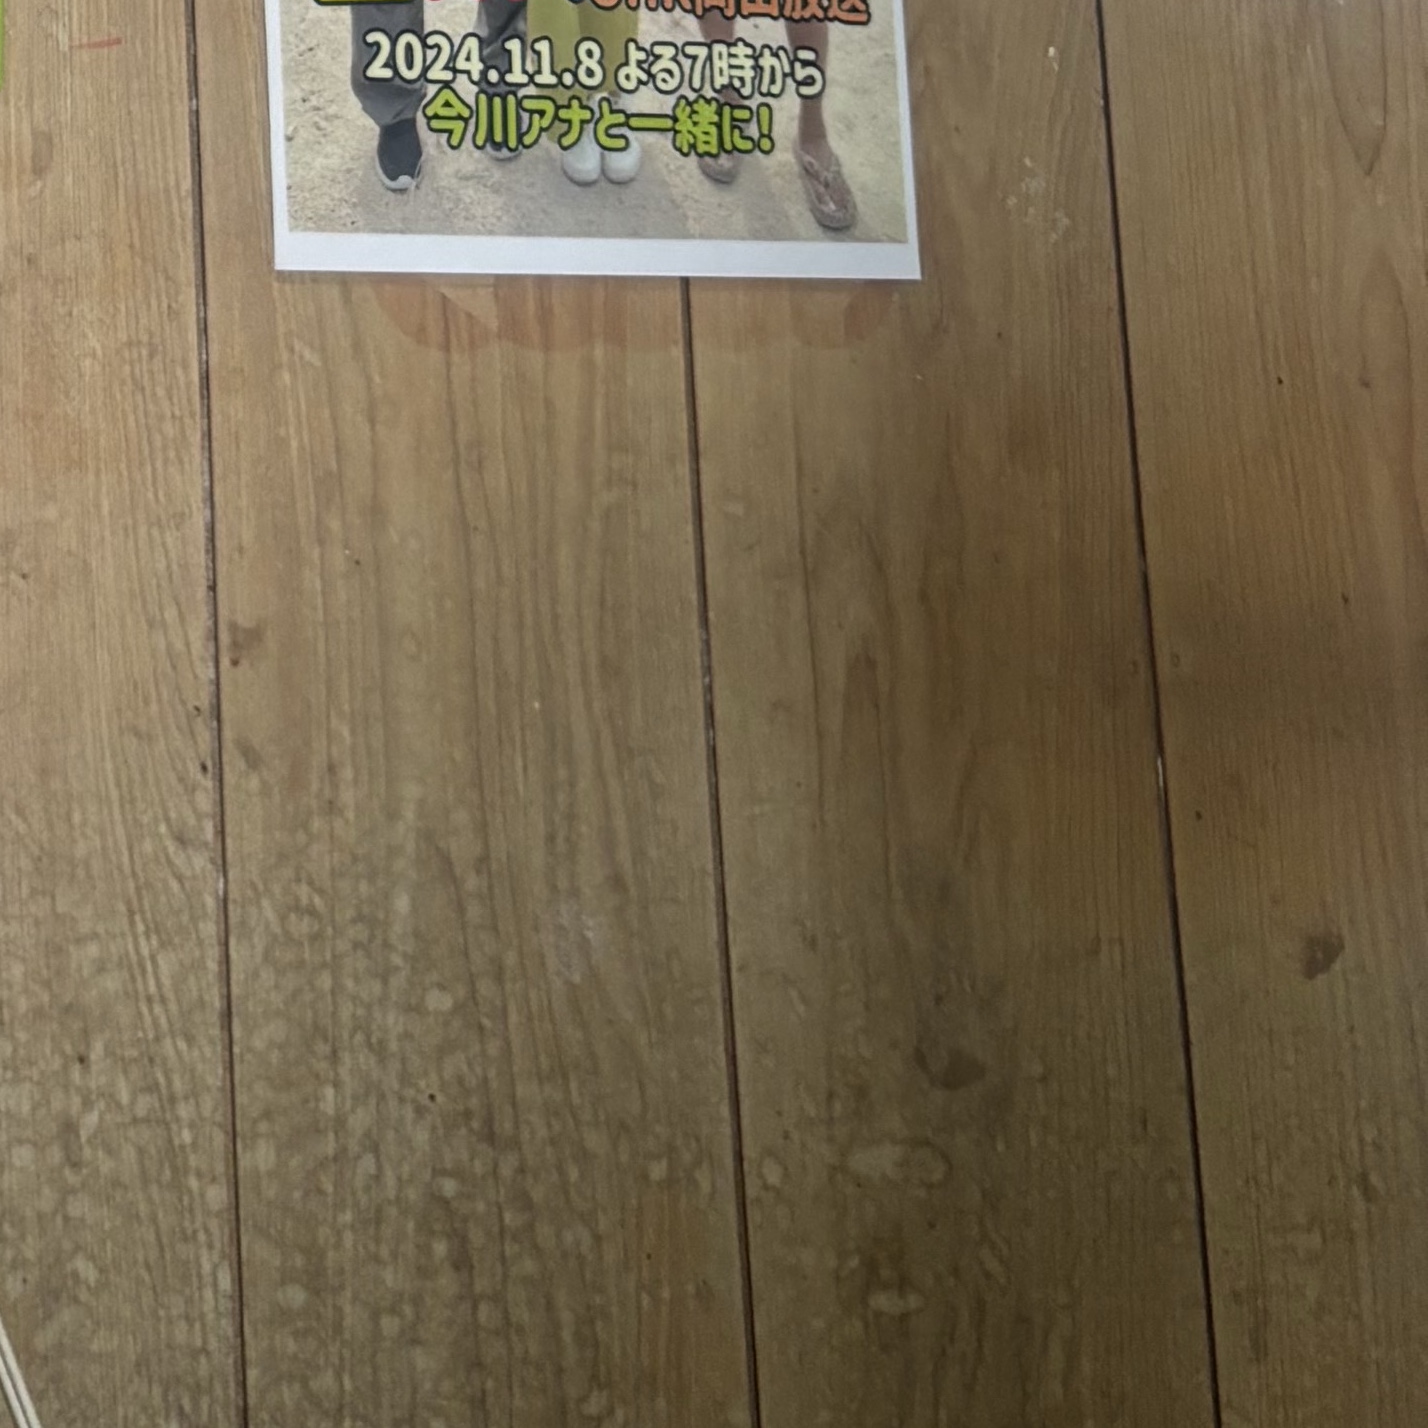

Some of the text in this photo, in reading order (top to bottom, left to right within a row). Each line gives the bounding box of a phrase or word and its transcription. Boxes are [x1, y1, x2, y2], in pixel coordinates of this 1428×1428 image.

[362, 29, 827, 100] 2024.11.8 よる7時から
[423, 87, 776, 157] 今川アナと一緒に!
